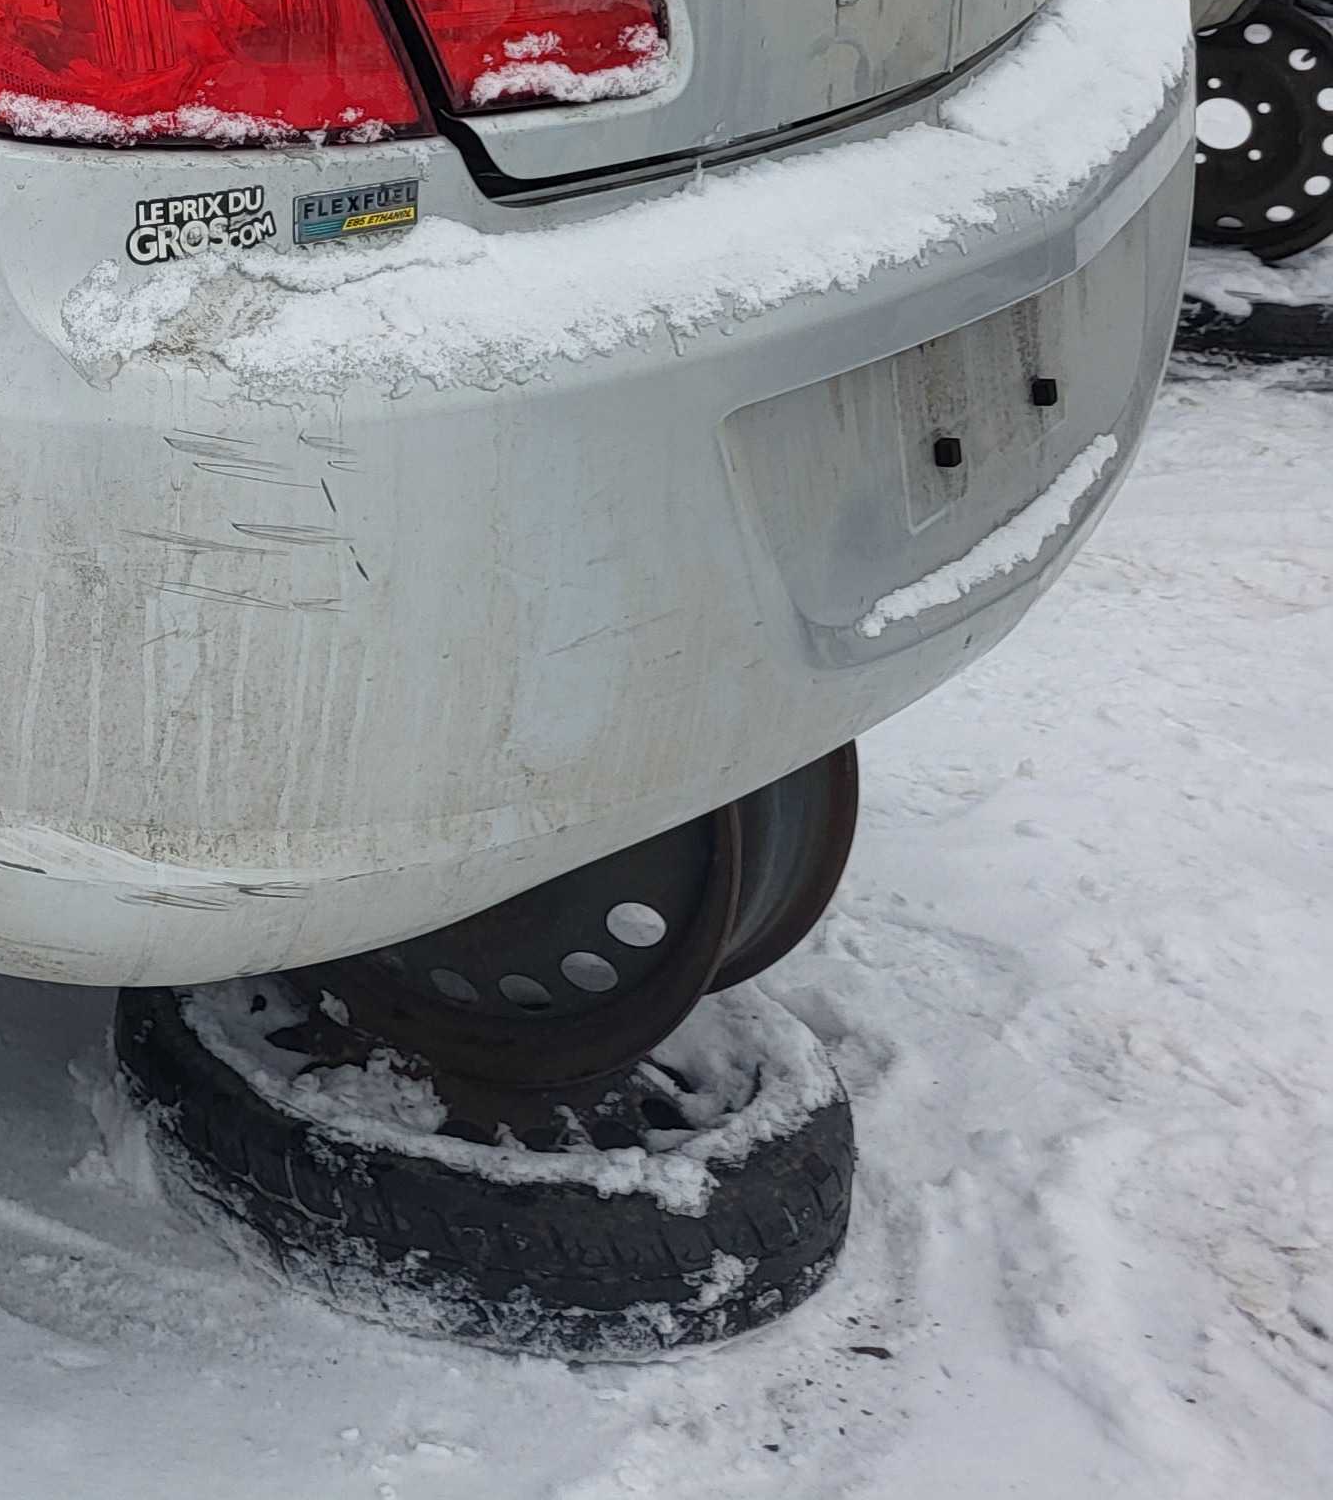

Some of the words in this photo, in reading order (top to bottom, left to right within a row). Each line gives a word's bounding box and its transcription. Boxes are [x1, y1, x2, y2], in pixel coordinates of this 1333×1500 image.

[138, 202, 165, 226] LE
[168, 195, 224, 223] PRIX
[228, 188, 262, 214] DU
[346, 216, 366, 228] E85
